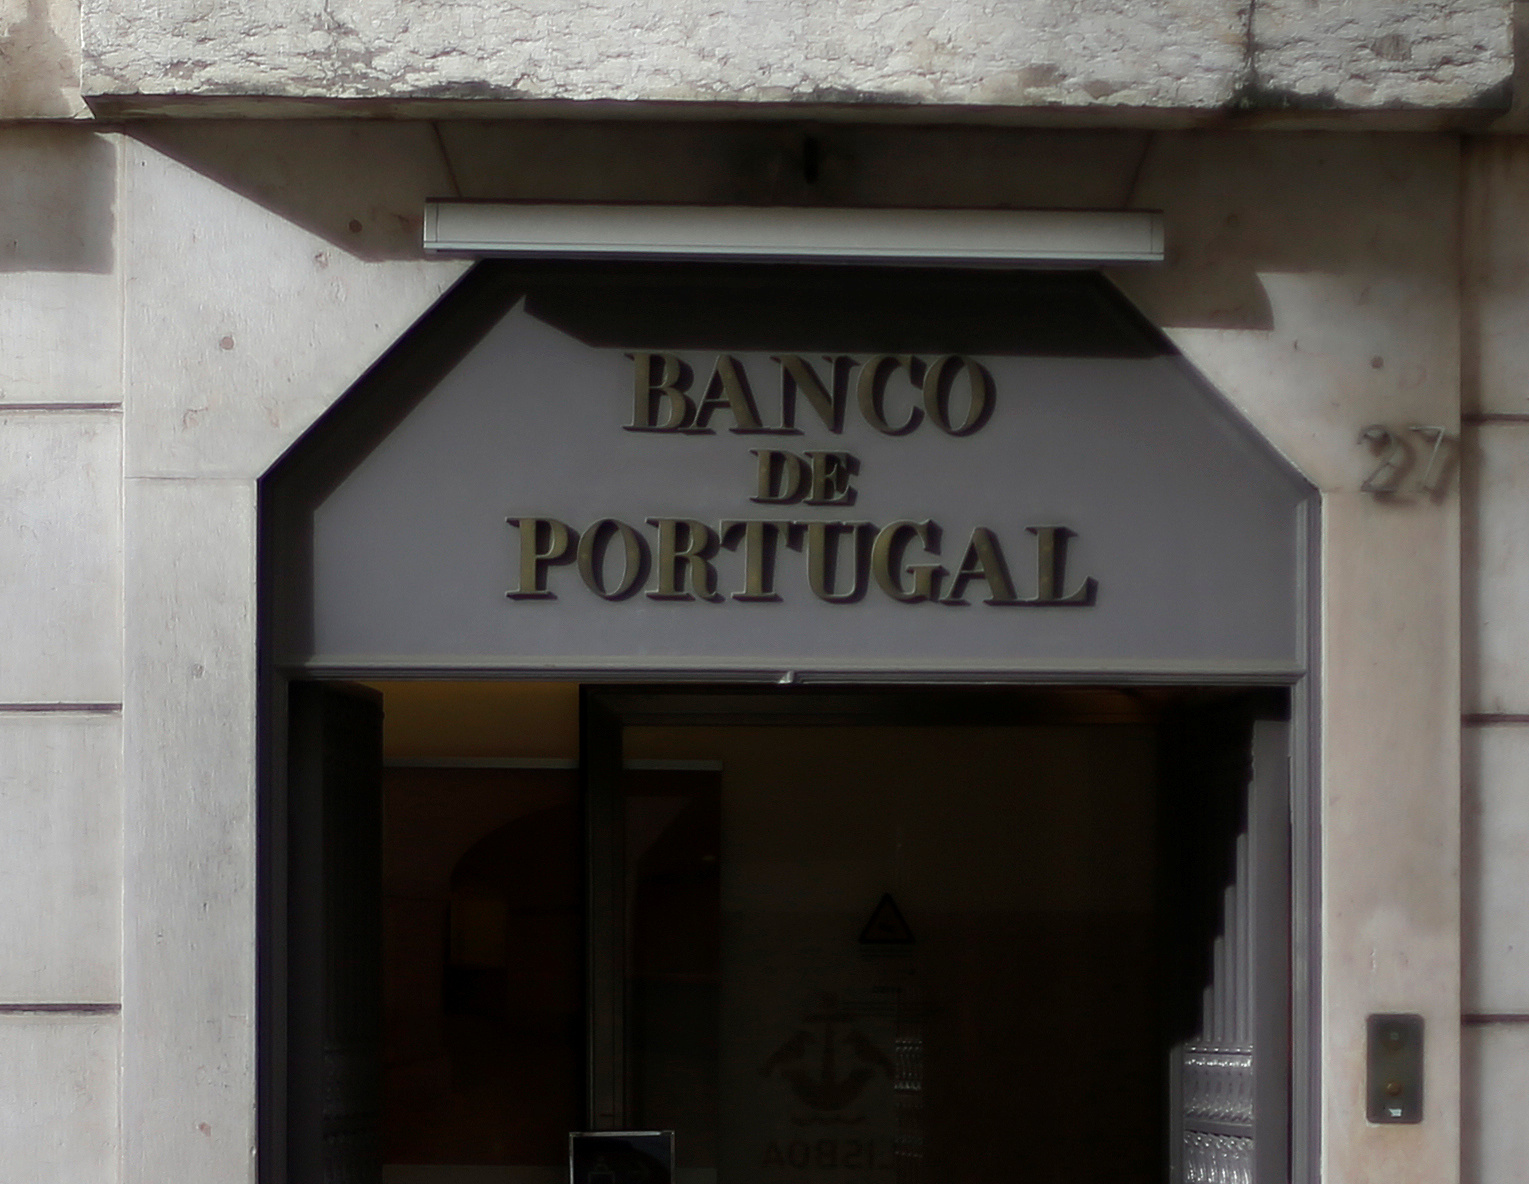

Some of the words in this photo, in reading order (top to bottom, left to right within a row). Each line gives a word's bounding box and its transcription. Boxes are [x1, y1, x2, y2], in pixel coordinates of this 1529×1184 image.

[622, 352, 997, 437] BANCO
[749, 449, 860, 506] DE
[1356, 424, 1448, 496] 27
[504, 516, 1099, 606] PORTUGAL
